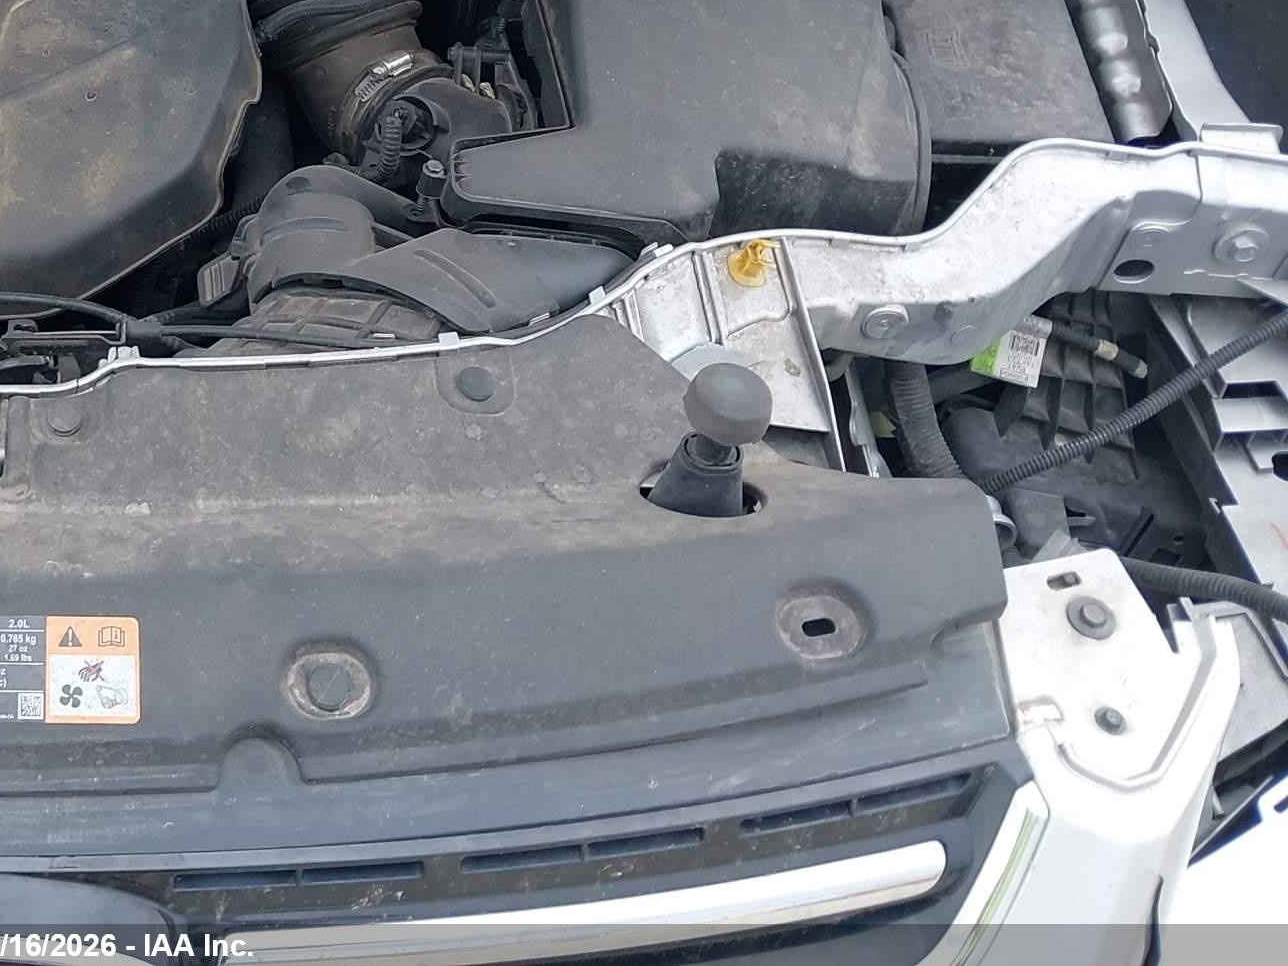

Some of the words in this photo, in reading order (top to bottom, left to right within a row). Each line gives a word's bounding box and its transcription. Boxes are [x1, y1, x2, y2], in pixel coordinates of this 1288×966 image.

[9, 619, 30, 628] 2.0L
[0, 634, 24, 643] 0.765
[25, 634, 37, 645] kg
[4, 654, 19, 662] 1.69
[20, 654, 32, 662] lbs
